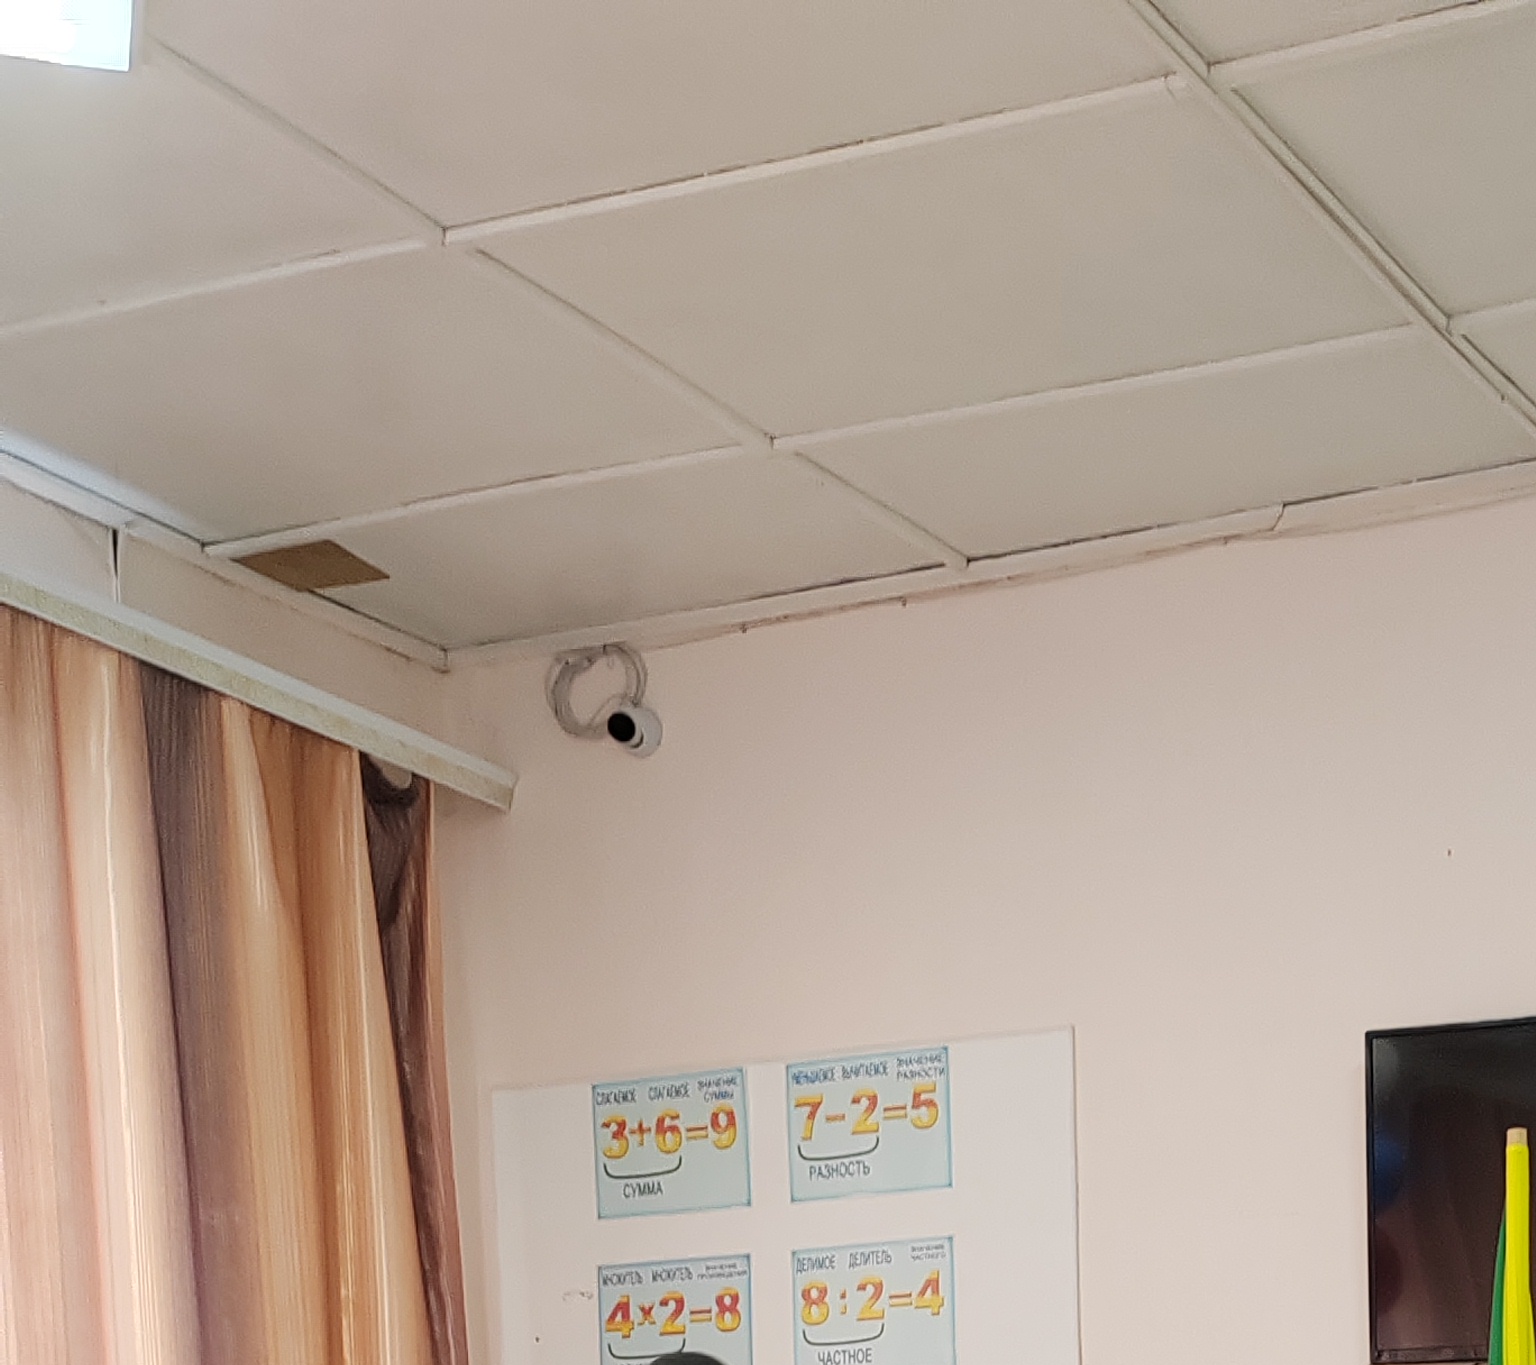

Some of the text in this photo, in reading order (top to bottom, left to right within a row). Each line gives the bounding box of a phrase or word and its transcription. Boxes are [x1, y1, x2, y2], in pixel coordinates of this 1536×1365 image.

[809, 1161, 870, 1181] РАЗНОСТЬ
[622, 1181, 663, 1198] СУММА
[796, 1255, 836, 1274] ДЕЛИМОЕ
[848, 1250, 892, 1270] ДЕЛИТЕЛЬ
[817, 1348, 872, 1365] ЧАСТНОЕ
